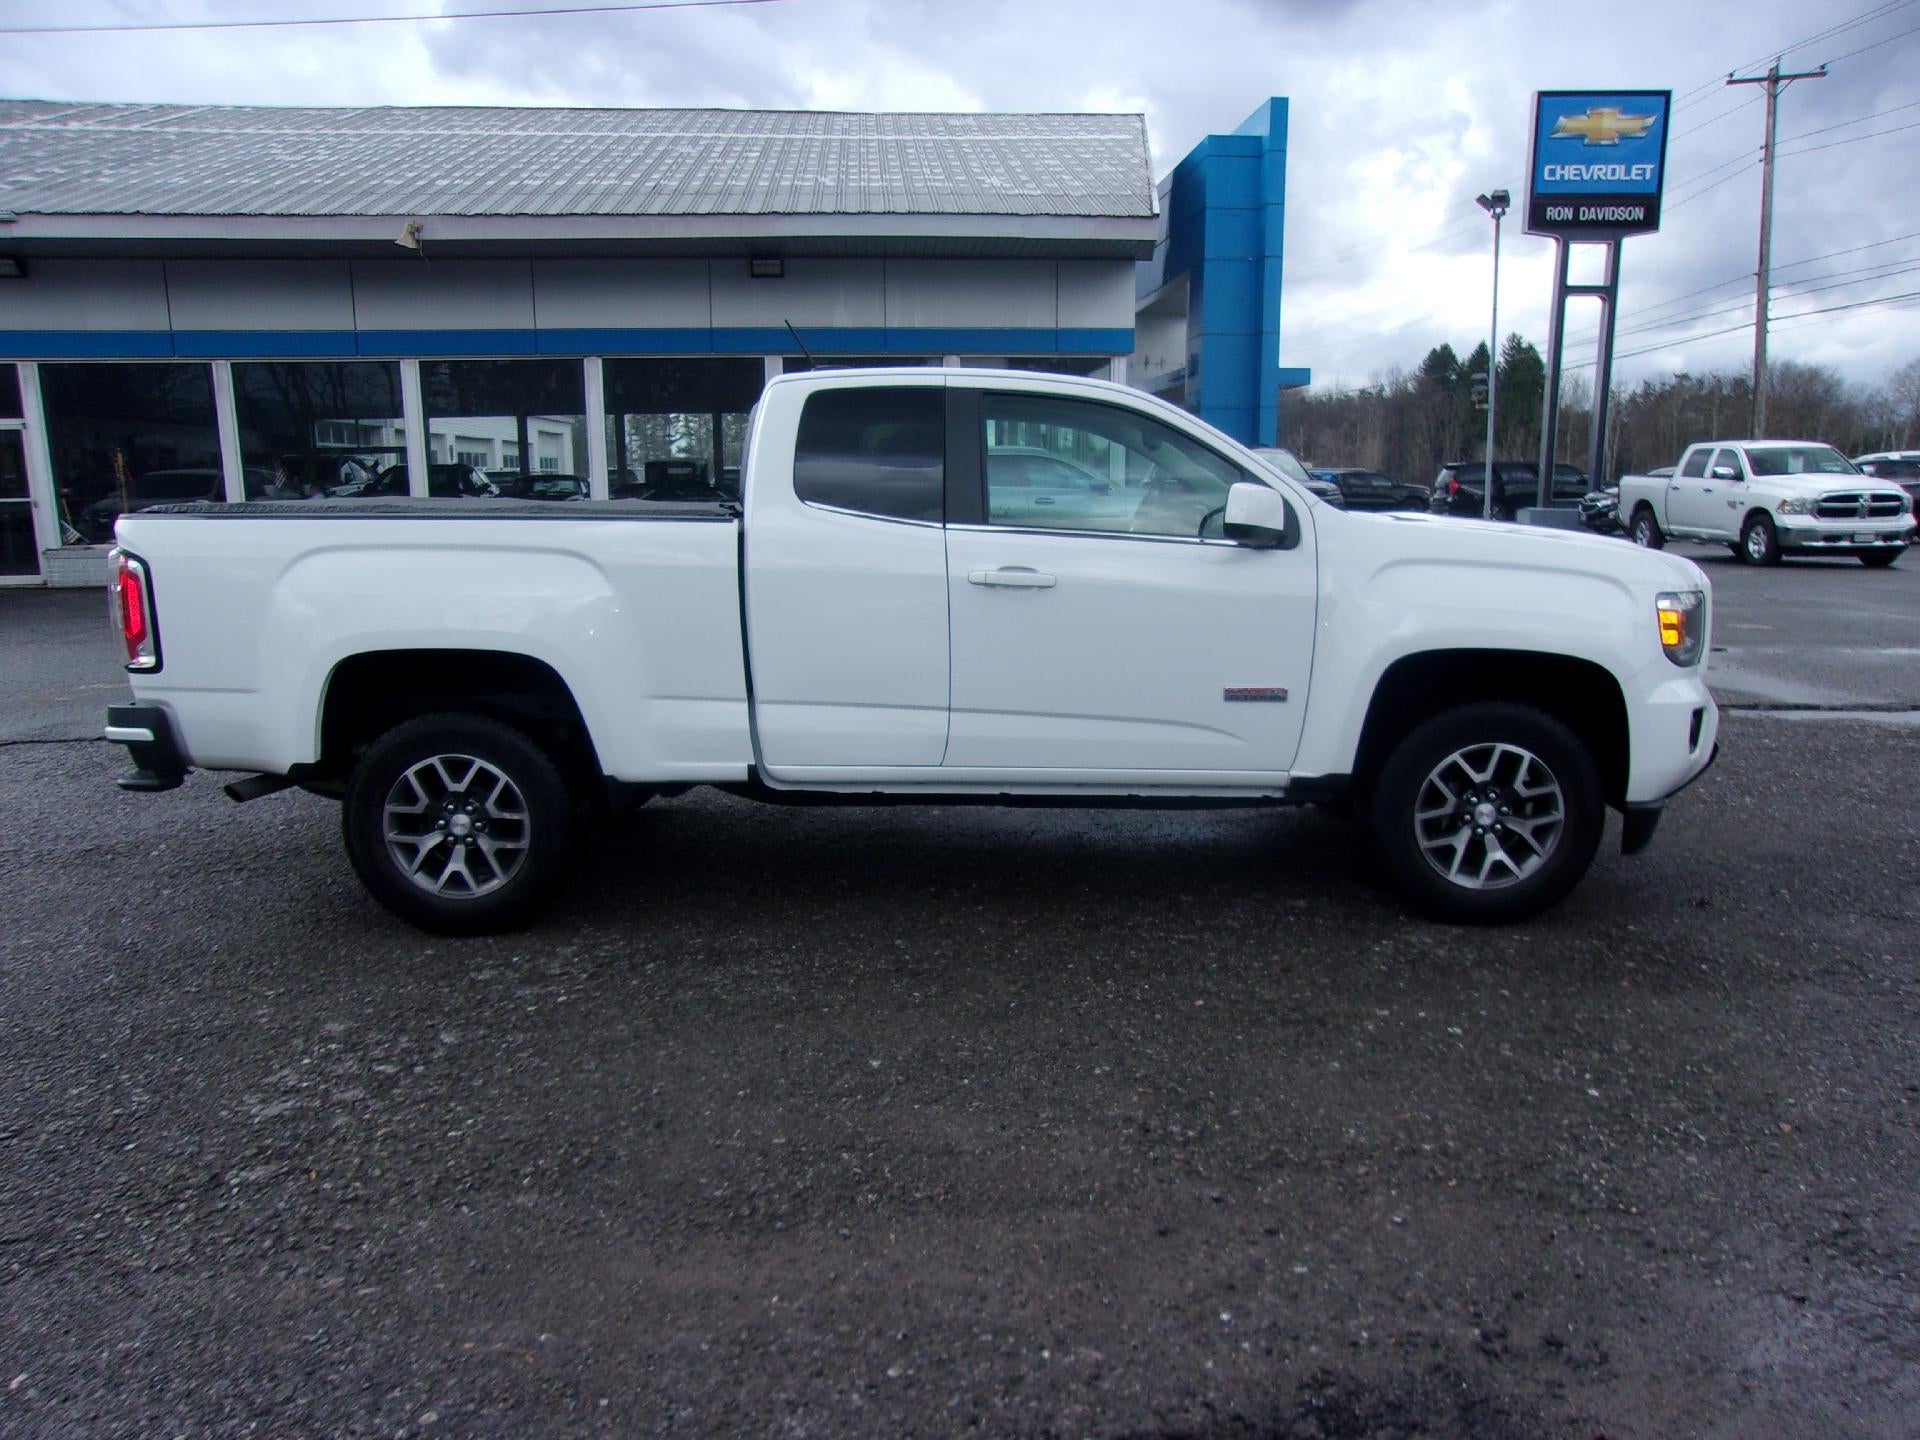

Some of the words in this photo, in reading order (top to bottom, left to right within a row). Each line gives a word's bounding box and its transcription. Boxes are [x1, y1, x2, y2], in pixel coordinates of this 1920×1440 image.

[1543, 164, 1655, 181] CHEVROLET
[1546, 206, 1573, 221] RON
[1579, 206, 1644, 221] DAVIDSON
